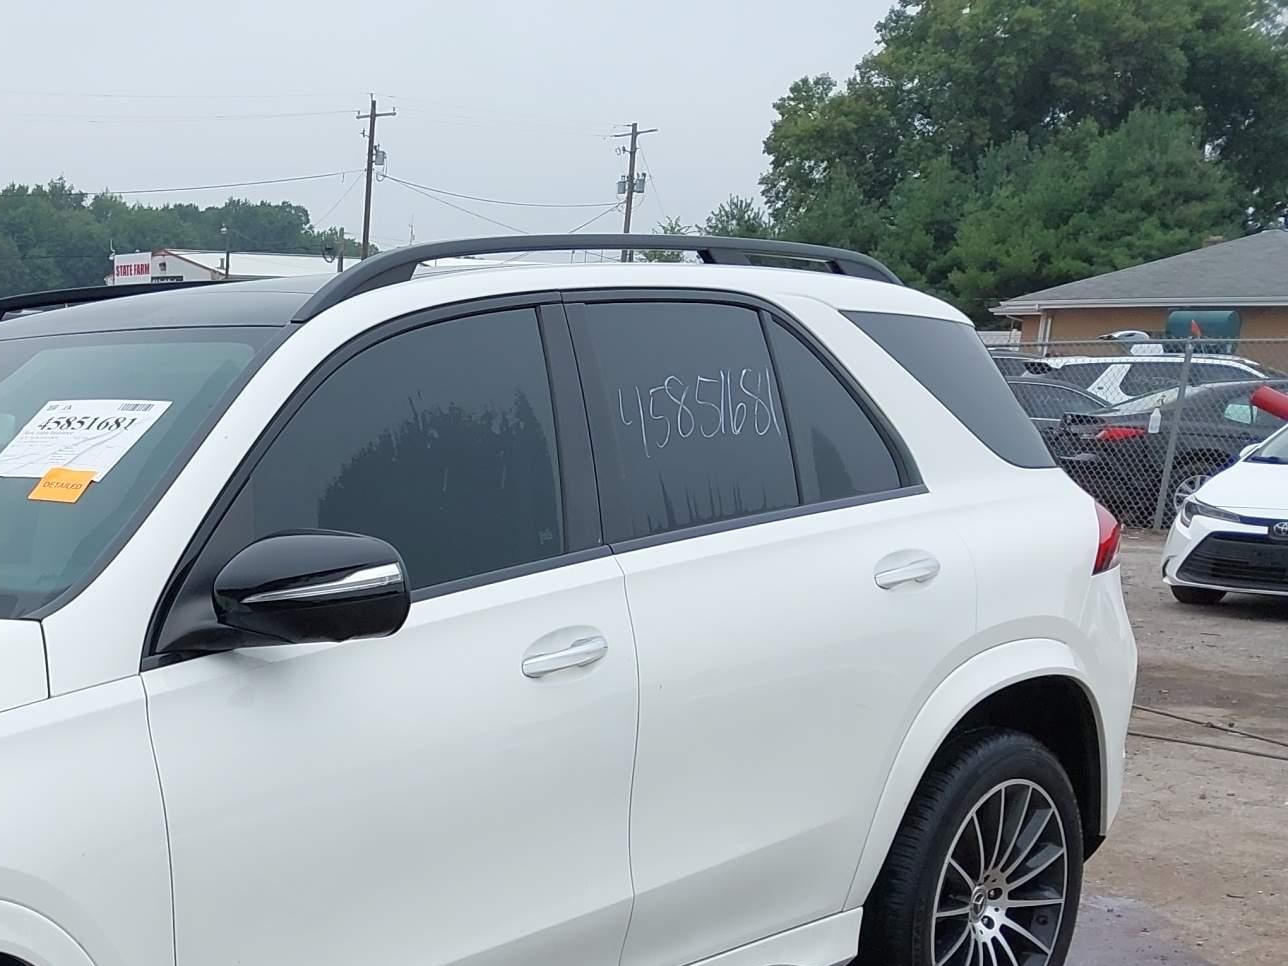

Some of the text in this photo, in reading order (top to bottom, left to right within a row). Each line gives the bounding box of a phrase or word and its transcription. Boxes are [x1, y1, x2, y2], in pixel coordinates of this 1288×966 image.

[116, 263, 150, 277] STATE FARM
[618, 367, 781, 459] 45851681
[37, 416, 137, 431] 45851681
[42, 480, 83, 490] DETAILED
